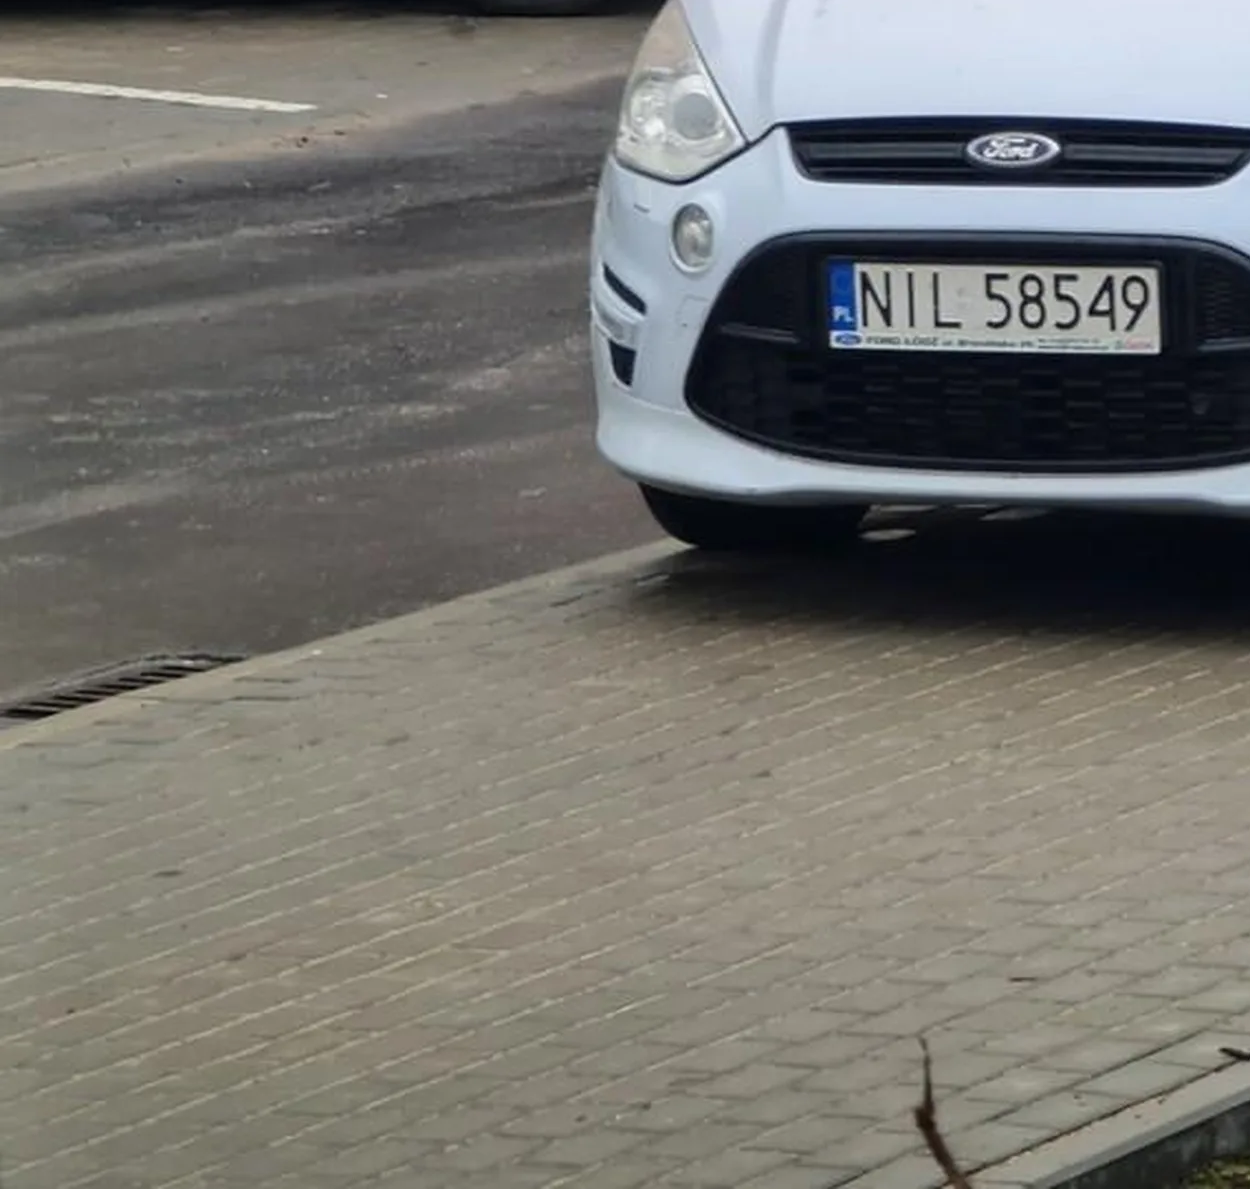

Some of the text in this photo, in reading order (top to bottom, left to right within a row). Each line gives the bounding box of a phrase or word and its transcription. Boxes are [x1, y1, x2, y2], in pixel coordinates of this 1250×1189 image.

[982, 138, 1039, 159] Ford
[860, 271, 1150, 332] NIL 58549
